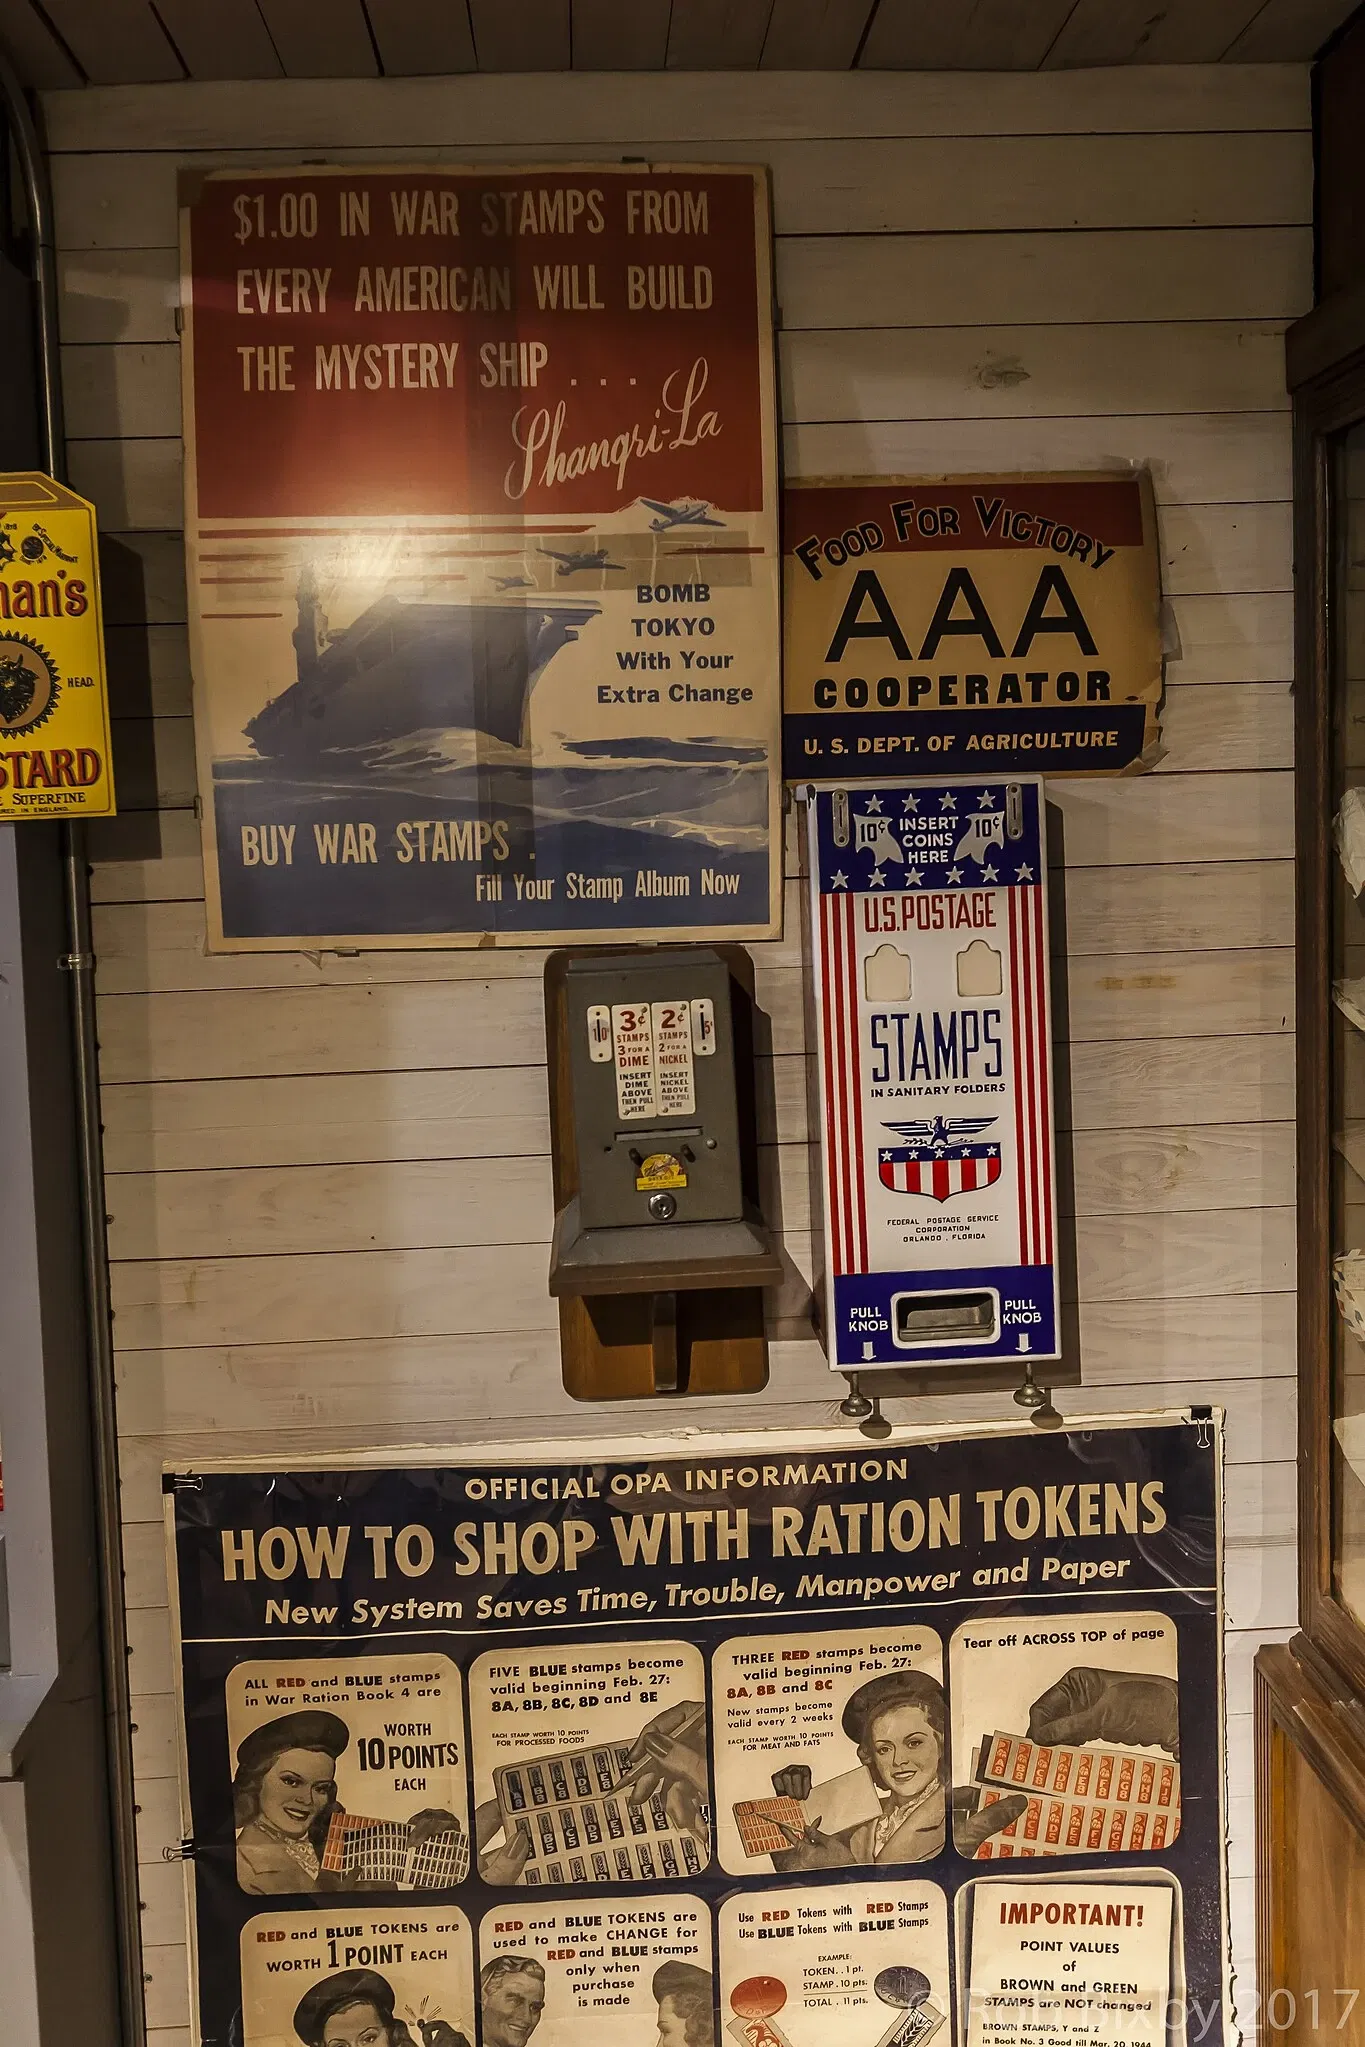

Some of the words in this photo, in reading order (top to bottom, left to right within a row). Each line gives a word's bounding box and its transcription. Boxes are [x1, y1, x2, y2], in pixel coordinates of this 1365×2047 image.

[233, 193, 317, 245] $1.00
[340, 192, 370, 236] IN
[393, 192, 460, 236] WAR
[481, 190, 605, 236] STAMPS
[626, 190, 709, 234] FROM
[237, 268, 331, 314] EVERY
[355, 266, 510, 312] AMERICAN
[533, 265, 605, 310] WILL
[628, 265, 713, 310] BUILD
[237, 346, 294, 391] THE
[315, 343, 459, 390] MYSTERY
[480, 342, 548, 387] SHIP
[503, 356, 723, 499] Shangri-La
[637, 583, 711, 603] BOMB
[631, 617, 715, 637] TOKYO
[616, 652, 670, 670] With
[680, 651, 734, 669] Your
[597, 685, 660, 704] Extra
[668, 684, 753, 705] Change
[813, 671, 1111, 709] COOPERATOR
[804, 739, 823, 755] U.
[830, 739, 849, 753] S.
[857, 736, 919, 753] DEPT.
[928, 735, 955, 751] OF
[966, 731, 1118, 750] AGRICULTURE
[860, 820, 886, 842] 10¢
[900, 816, 958, 831] INSERT
[975, 818, 1000, 838] 10¢
[241, 825, 295, 865] BUY
[314, 823, 377, 864] WAR
[397, 821, 510, 863] STAMPS
[902, 833, 953, 848] COINS
[908, 850, 948, 864] HERE
[476, 873, 502, 901] Fill
[512, 873, 554, 901] Your
[566, 872, 623, 903] Stamp
[635, 870, 690, 898] Album
[701, 869, 740, 896] Now
[617, 1033, 649, 1043] STAMPS
[659, 1032, 687, 1040] STAMPS
[618, 1045, 625, 1055] 3
[659, 1043, 665, 1052] 2
[871, 1009, 1002, 1083] STAMPS
[620, 1055, 649, 1067] DIME
[660, 1054, 688, 1064] NICKEL
[620, 1072, 651, 1080] INSERT
[622, 1089, 652, 1097] ABOVE
[871, 1088, 883, 1097] IN
[887, 1085, 950, 1097] SANITARY
[954, 1083, 1005, 1093] FOLDERS
[851, 1307, 881, 1318] PULL
[1005, 1300, 1036, 1310] PULL
[849, 1320, 888, 1332] KNOB
[1003, 1312, 1042, 1324] KNOB
[465, 1476, 600, 1500] OFFICIAL
[610, 1471, 672, 1496] OPA
[685, 1459, 908, 1491] INFORMATION
[221, 1525, 350, 1581] HOW
[364, 1524, 434, 1579] TO
[454, 1520, 597, 1576] SHOP
[610, 1508, 749, 1566] WITH
[772, 1493, 960, 1558] RATION
[976, 1481, 1167, 1542] TOKENS
[265, 1599, 338, 1625] New
[352, 1598, 463, 1628] System
[476, 1595, 567, 1620] Saves
[577, 1588, 657, 1613] Time,
[665, 1575, 784, 1609] Trouble,
[796, 1572, 961, 1601] Manpower
[972, 1557, 1029, 1585] and
[1042, 1557, 1131, 1584] Paper
[963, 1638, 992, 1649] Tear
[998, 1635, 1017, 1646] off
[1023, 1632, 1076, 1646] ACROSS
[1081, 1631, 1107, 1643] TOP
[1113, 1629, 1126, 1641] of
[1132, 1630, 1165, 1641] page
[732, 1653, 774, 1665] THREE
[781, 1650, 810, 1661] RED
[816, 1645, 863, 1659] stamps
[870, 1642, 922, 1655] become
[490, 1666, 520, 1678] FIVE
[529, 1664, 567, 1677] BLUE
[571, 1661, 621, 1675] stamps
[628, 1658, 684, 1670] become
[245, 1679, 268, 1689] ALL
[276, 1678, 305, 1688] RED
[311, 1676, 338, 1687] and
[345, 1676, 382, 1686] BLUE
[389, 1672, 440, 1686] stamps
[245, 1696, 258, 1706] in
[265, 1696, 295, 1705] War
[303, 1692, 350, 1704] Ration
[357, 1690, 394, 1701] Book
[401, 1688, 410, 1698] 4
[418, 1689, 441, 1697] are
[384, 1723, 431, 1736] WORTH
[357, 1738, 385, 1771] 10
[389, 1742, 458, 1769] POINTS
[394, 1778, 426, 1791] EACH
[1000, 1903, 1144, 1927] IMPORTANT!
[1020, 1941, 1063, 1952] POINT
[1069, 1942, 1120, 1953] VALUES
[267, 1958, 320, 1972] WORTH
[328, 1940, 339, 1968] 1
[345, 1943, 404, 1967] POINT
[411, 1950, 448, 1961] EACH
[818, 1954, 852, 1962] EXAMPLE:
[1062, 1961, 1077, 1972] of
[572, 1979, 635, 1993] purchase
[1000, 1979, 1054, 1991] BROWN
[1061, 1981, 1086, 1993] and
[1093, 1983, 1138, 1994] GREEN
[984, 1997, 1035, 2007] STAMPS
[1039, 2000, 1060, 2008] are
[1065, 1999, 1093, 2009] NOT
[1097, 2000, 1152, 2011] changed
